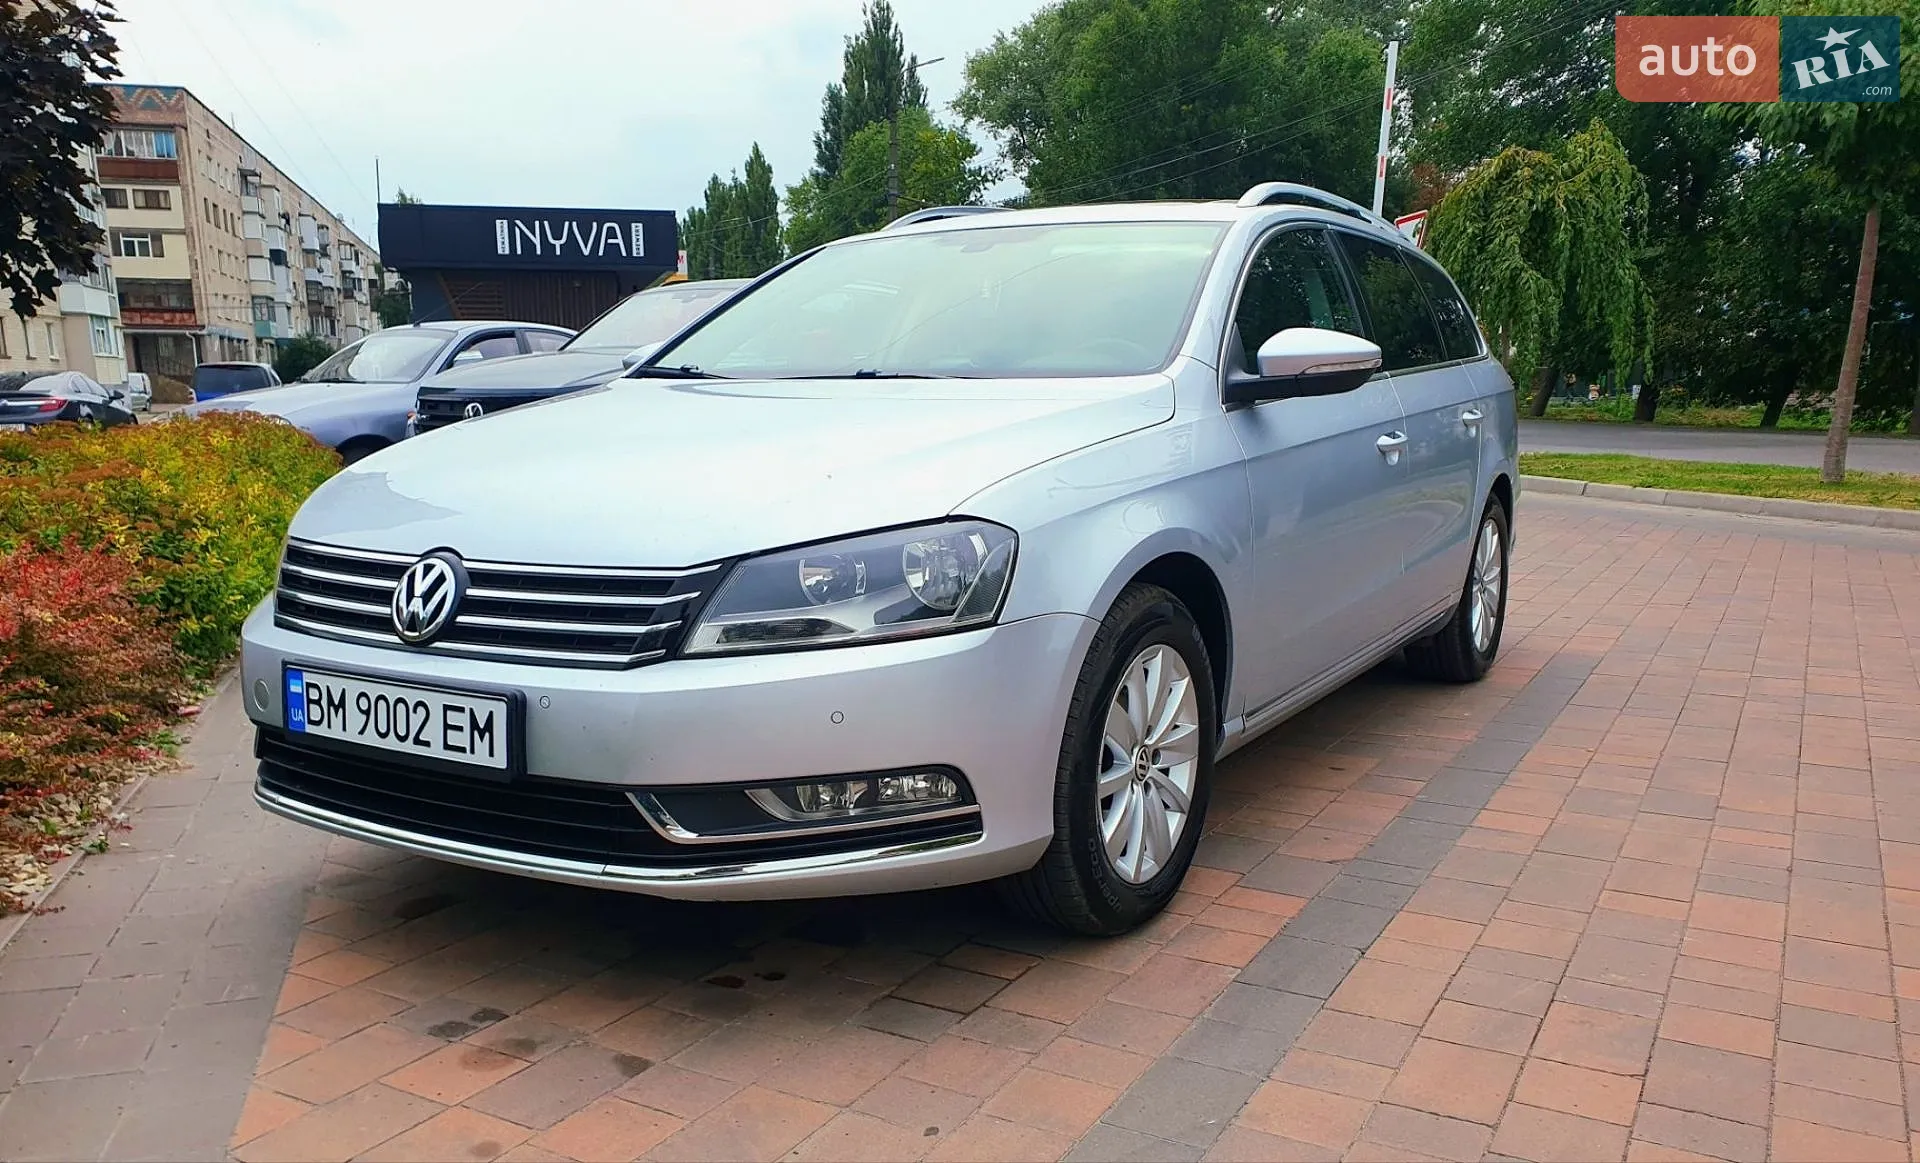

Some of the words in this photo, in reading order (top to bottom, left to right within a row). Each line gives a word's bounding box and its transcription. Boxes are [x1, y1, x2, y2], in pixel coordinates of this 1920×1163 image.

[514, 219, 627, 257] NYVA
[291, 708, 304, 724] UA
[304, 681, 347, 733] BM
[355, 691, 432, 748] 9002
[442, 703, 495, 758] EM
